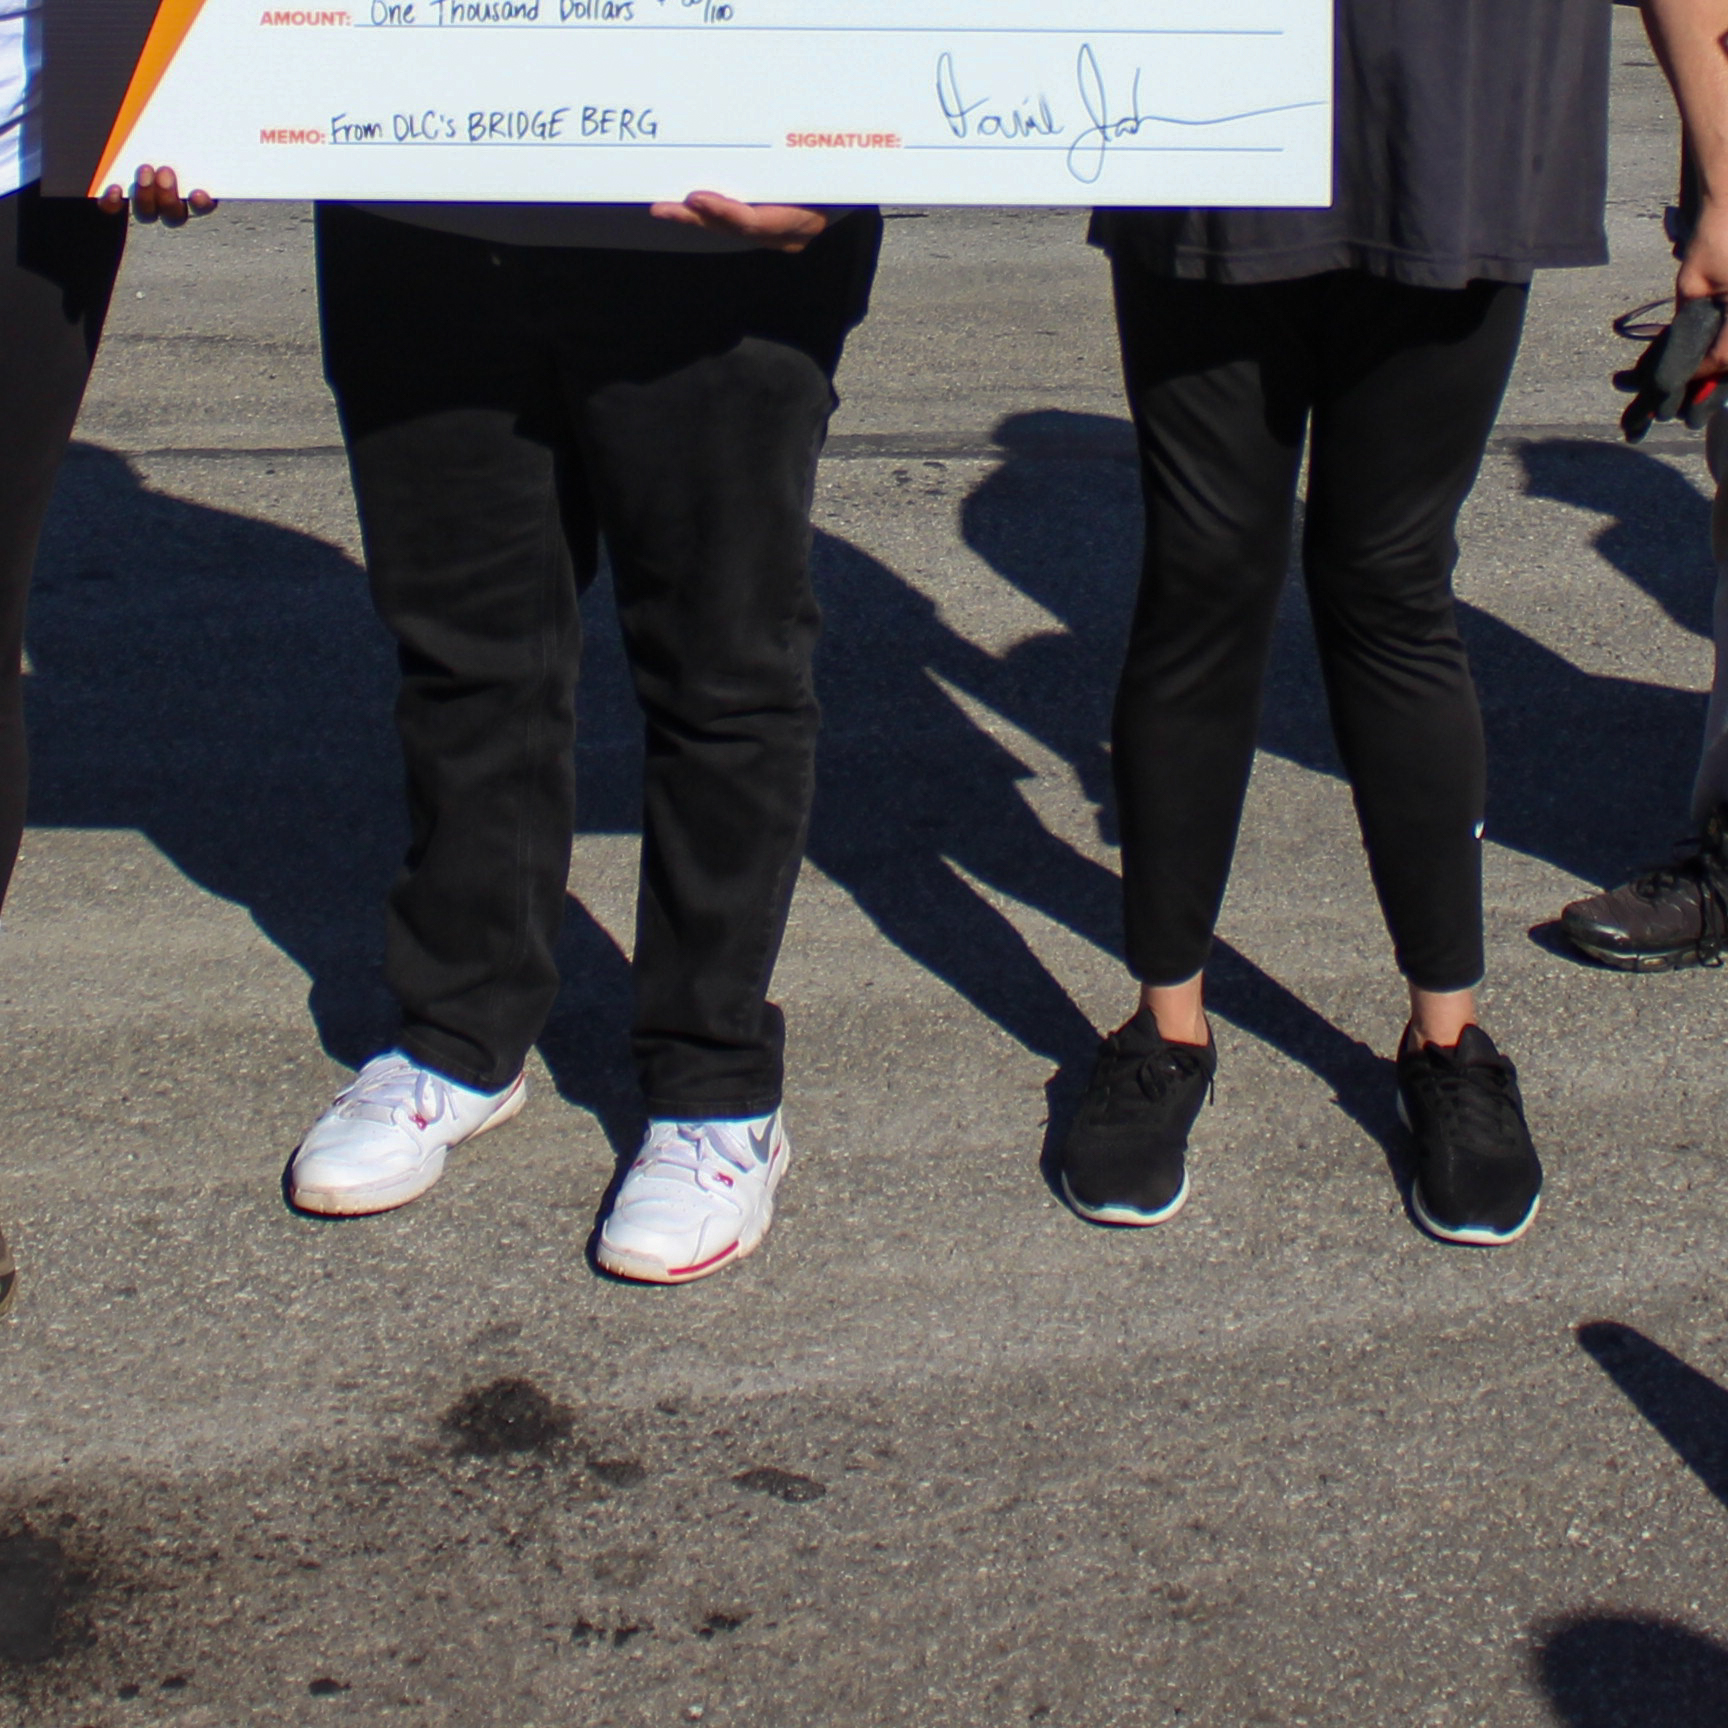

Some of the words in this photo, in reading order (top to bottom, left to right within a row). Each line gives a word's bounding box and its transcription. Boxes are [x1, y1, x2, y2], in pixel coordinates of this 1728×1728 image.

[259, 11, 351, 26] AMOUNT:
[330, 113, 383, 143] From
[393, 110, 457, 142] DLC's
[467, 106, 571, 141] BRIDGE
[580, 106, 658, 140] BERG
[259, 128, 325, 144] MEMO:
[785, 131, 902, 149] SIGNATURE:
